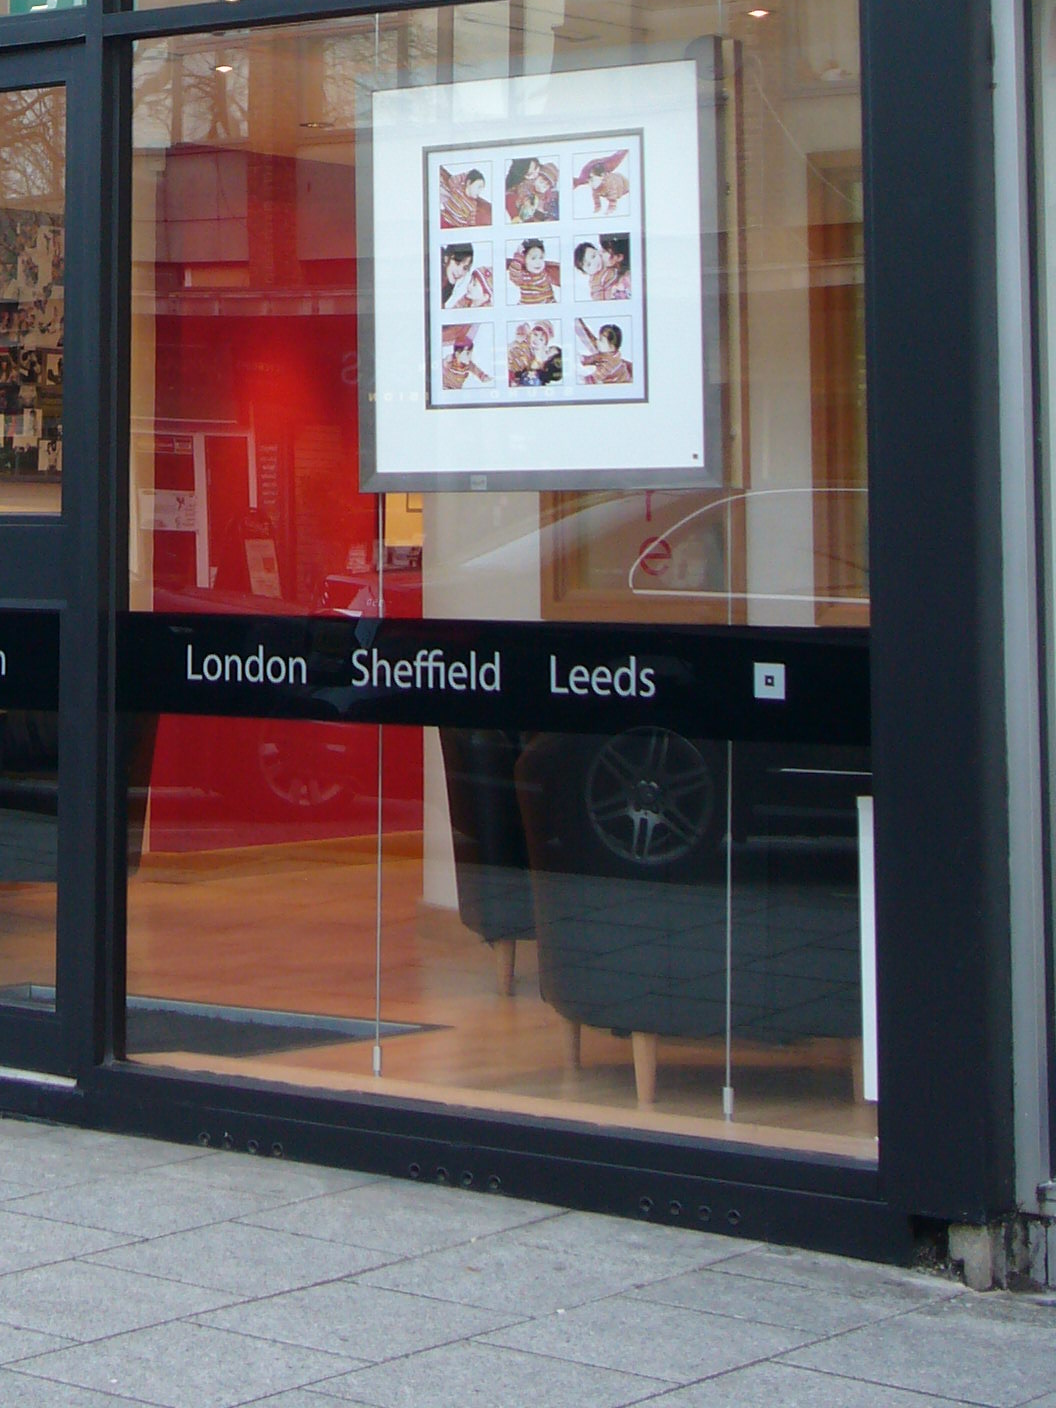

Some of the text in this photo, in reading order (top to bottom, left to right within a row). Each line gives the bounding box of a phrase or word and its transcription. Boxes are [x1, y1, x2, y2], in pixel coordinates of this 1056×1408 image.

[185, 644, 307, 685] London
[351, 649, 501, 691] Sheffield
[549, 654, 656, 697] Leeds
